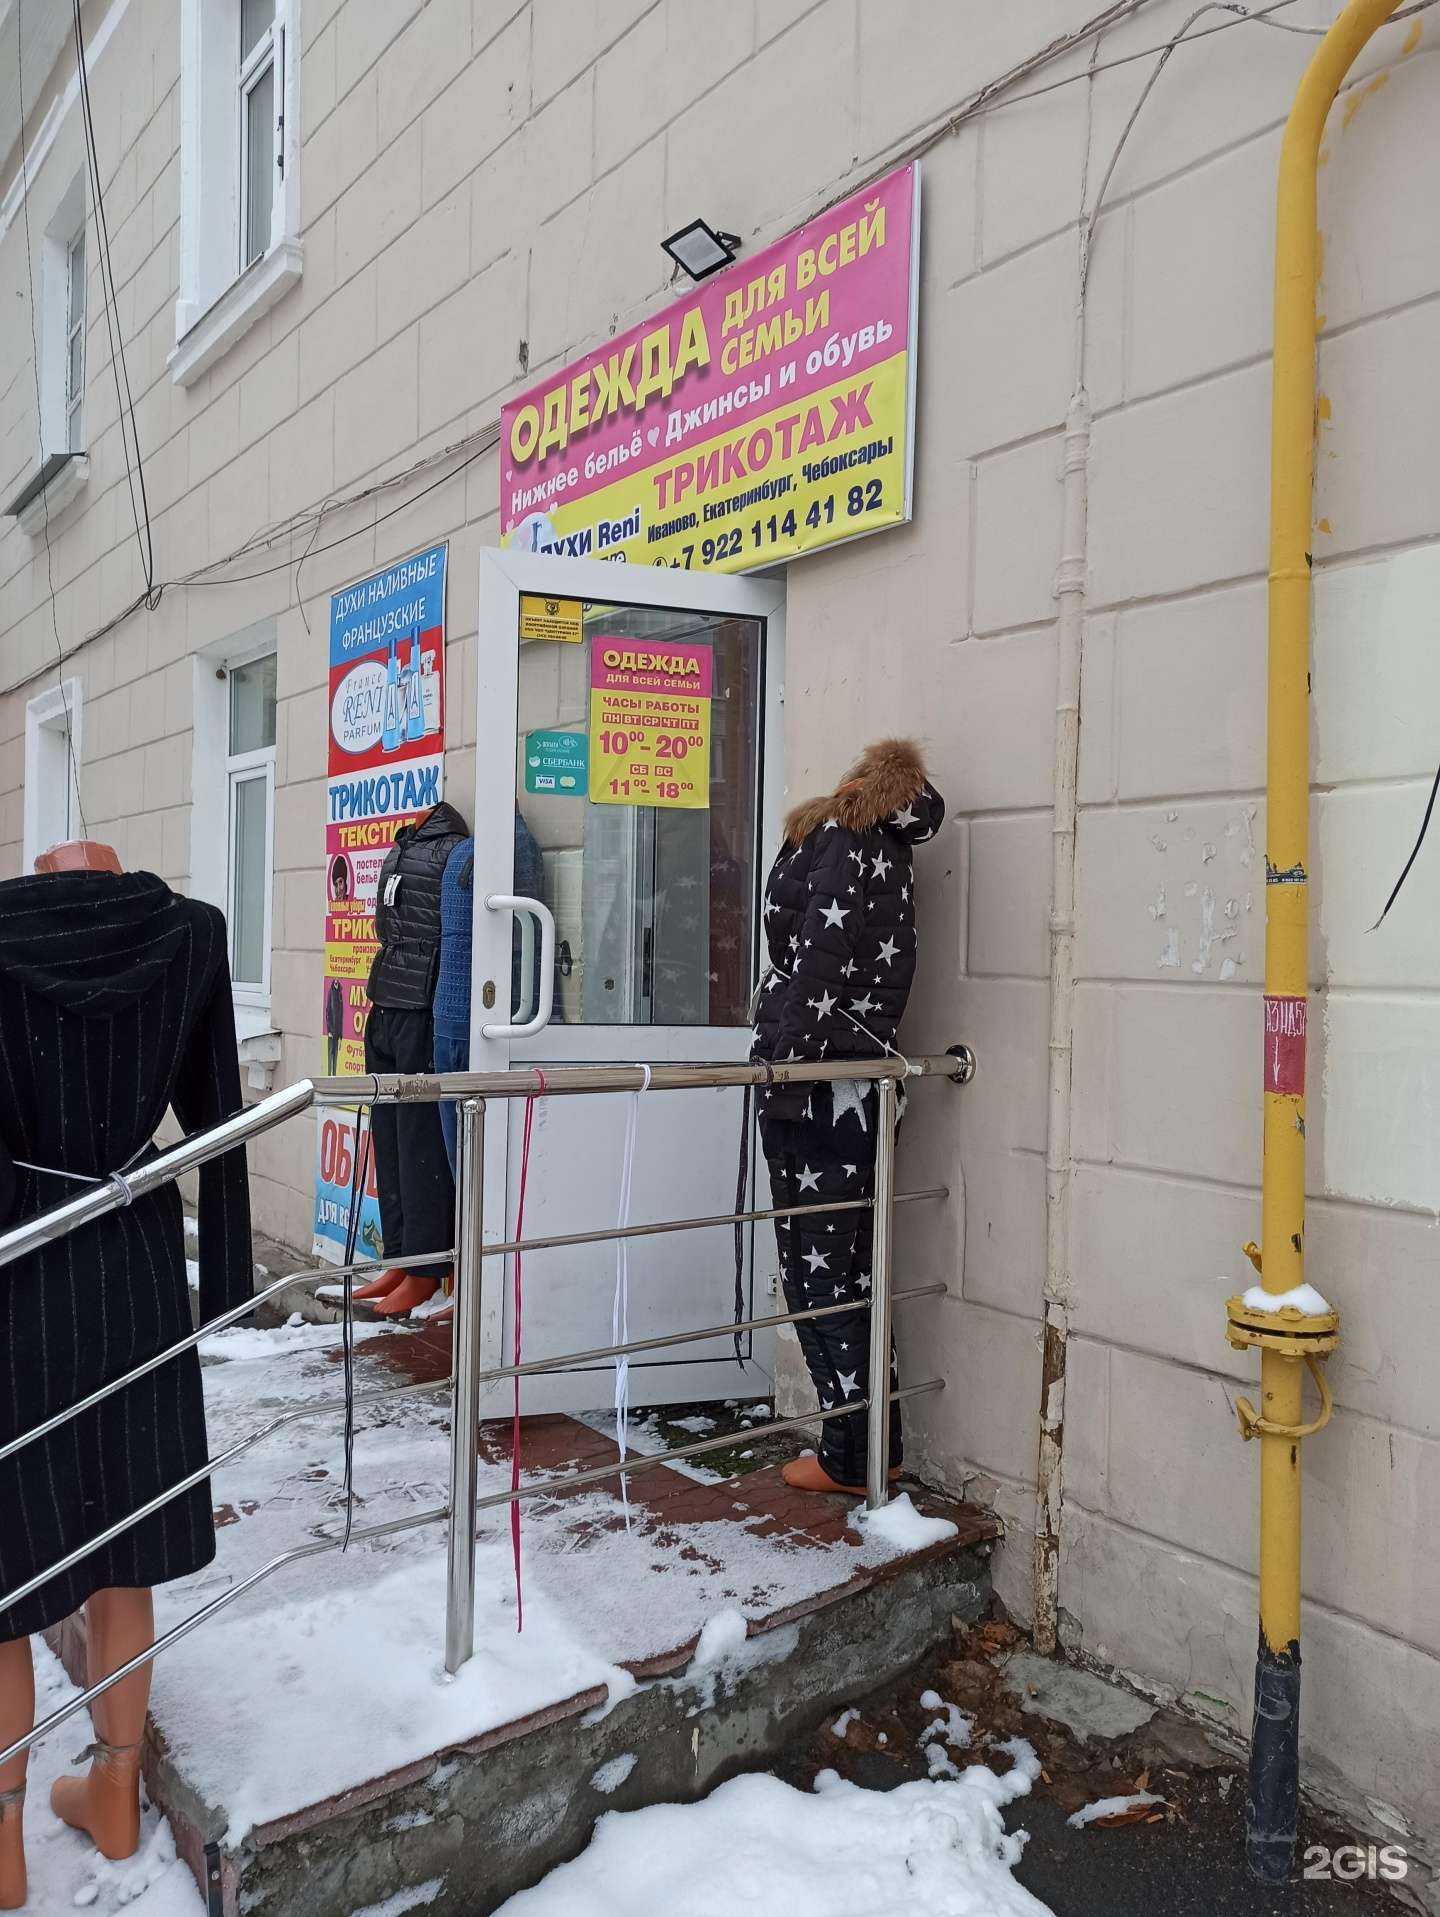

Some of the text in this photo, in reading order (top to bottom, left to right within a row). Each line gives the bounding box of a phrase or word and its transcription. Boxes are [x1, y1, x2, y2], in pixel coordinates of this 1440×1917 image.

[721, 197, 887, 338] ДЛЯ ВСЕЙ
[720, 289, 830, 376] СЕМЬИ
[510, 306, 710, 463] ОДЕЖДА
[665, 319, 893, 447] Джинсы и обувь
[653, 381, 874, 511] ТРИКОТАЖ
[511, 431, 644, 515] Нижнее бельё
[648, 434, 893, 544] Иваново, Екатеринбург, Чебоксары
[599, 507, 640, 549] Reni
[701, 529, 743, 565] 922
[752, 510, 797, 547] 114
[805, 501, 835, 530] 41
[847, 478, 883, 517] 82
[336, 552, 437, 625] ДУХИ НАЛИВНЫЕ
[342, 596, 426, 651] ФРАНЦУЗСКИЕ
[603, 649, 700, 676] ОДЕЖДА
[606, 672, 701, 691] ДЛЯ ВСЕЙ СЕМЬИ
[343, 686, 384, 726] RENI
[602, 696, 700, 714] ЧАСЫ РАБОТЫ
[603, 713, 698, 729] ПН ВТ СР ЧТ ПТ
[343, 721, 381, 741] PARFUM
[542, 757, 585, 767] СБЕРБАНК
[631, 765, 673, 777] СБ ВС
[329, 764, 439, 821] ТРИКОТАЖ
[338, 817, 417, 848] ТЕКСТИ
[356, 870, 378, 885] бельё
[332, 918, 377, 940] ТРИК
[350, 985, 373, 1008] МУ
[318, 1198, 337, 1225] ДЛЯ
